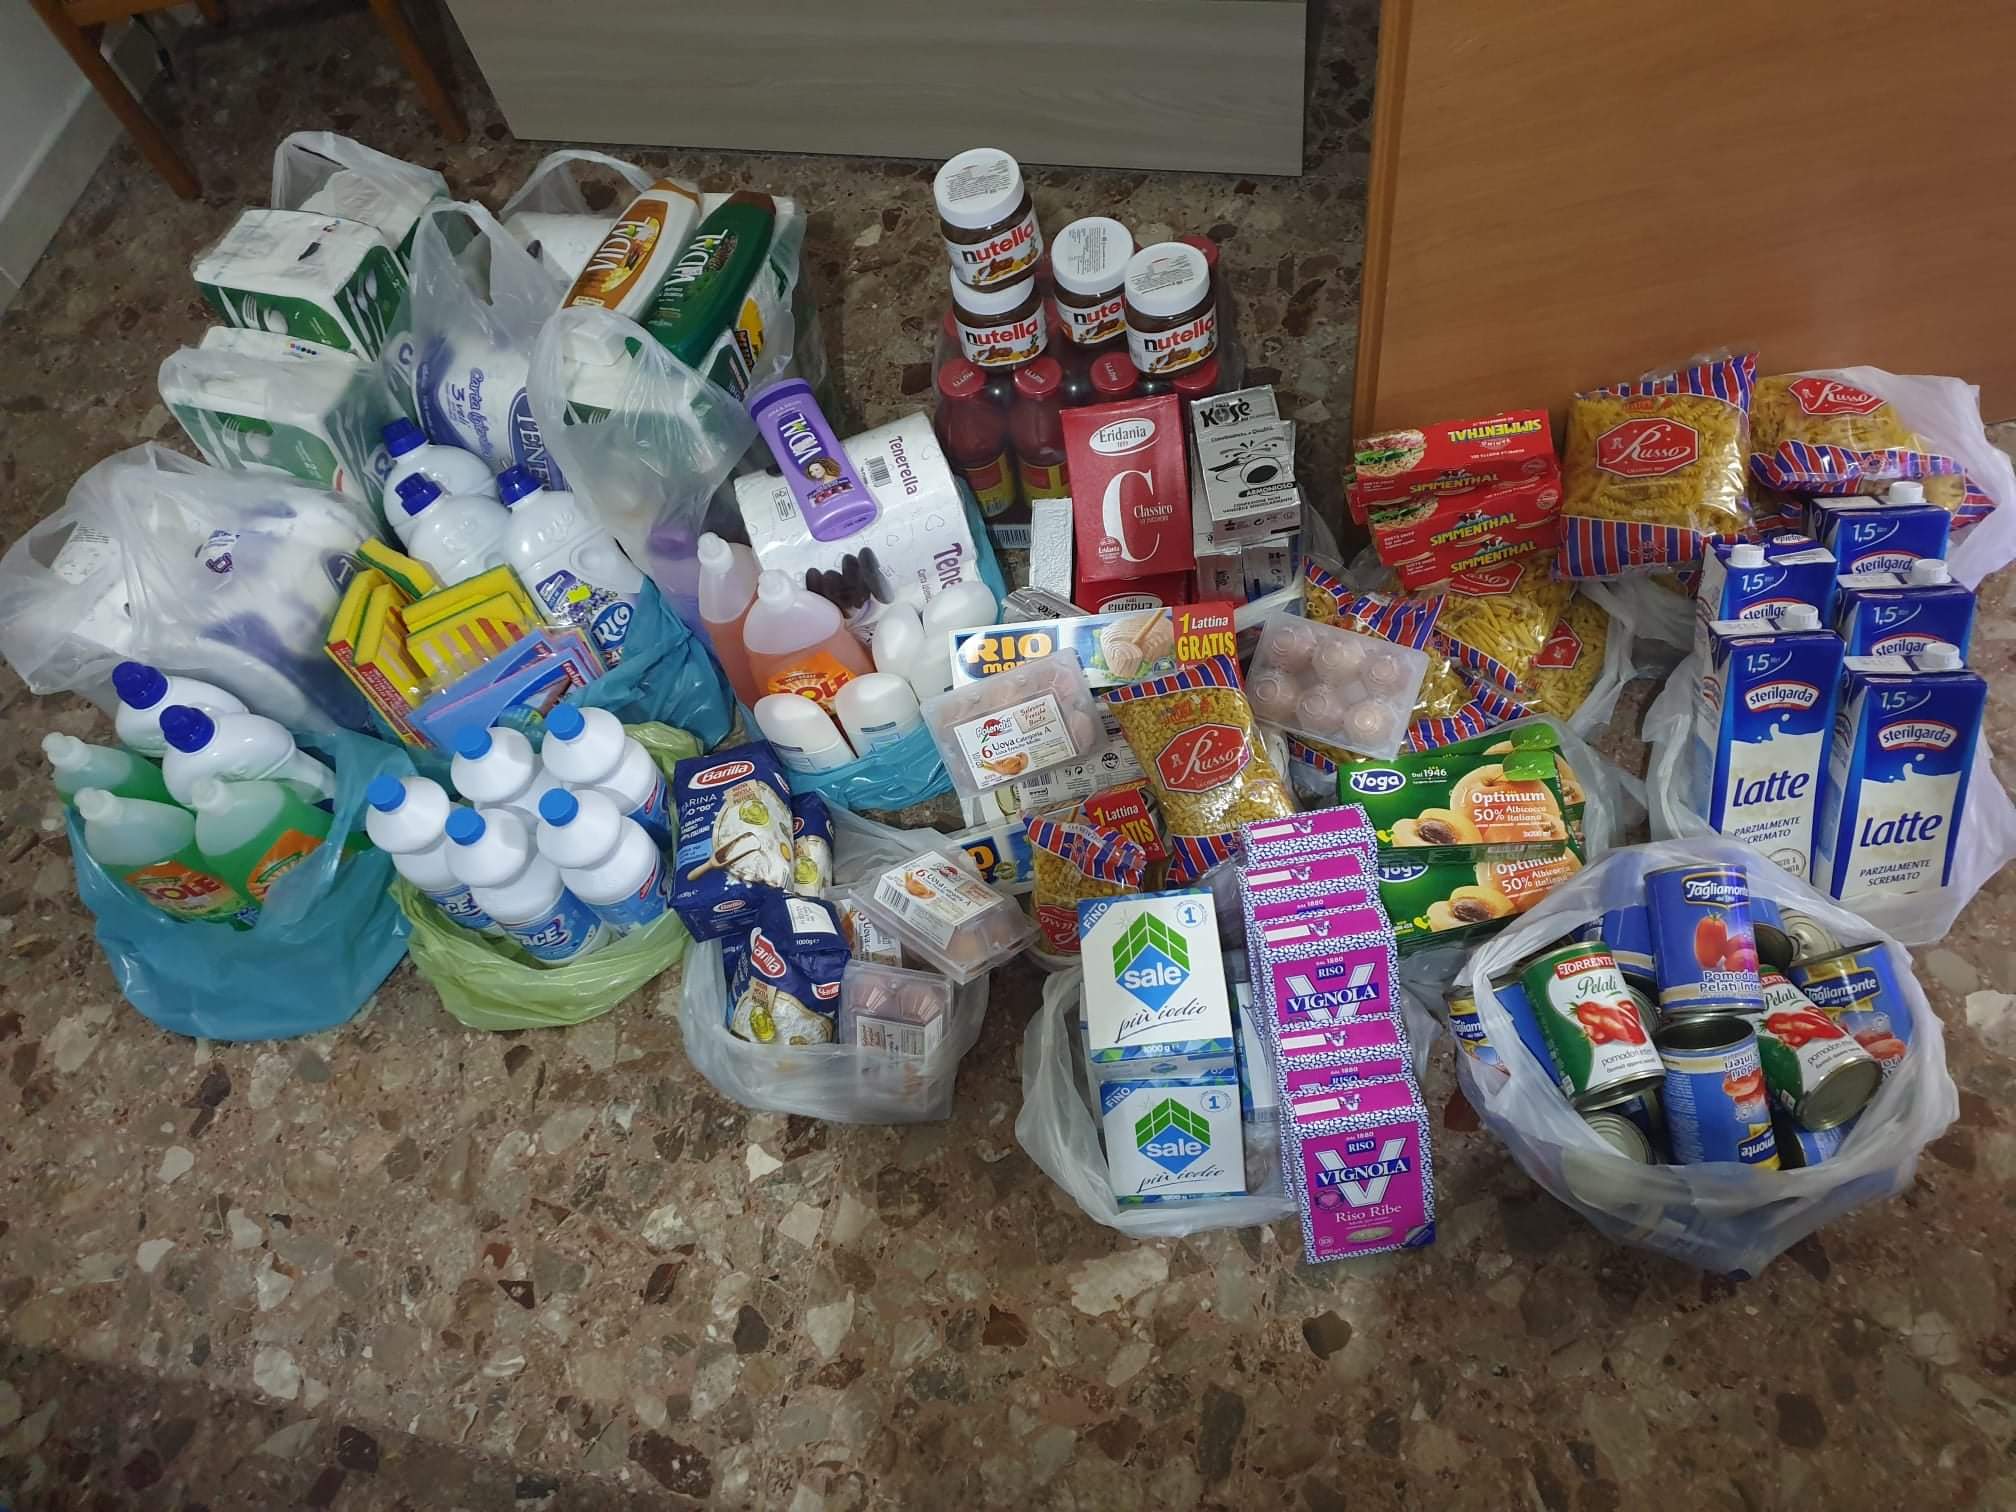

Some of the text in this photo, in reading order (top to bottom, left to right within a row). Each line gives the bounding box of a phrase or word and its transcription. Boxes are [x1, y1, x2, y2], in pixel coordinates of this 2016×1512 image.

[961, 222, 1035, 264] nutella
[1073, 295, 1126, 325] nutel
[964, 318, 1039, 346] nutella
[1143, 316, 1216, 352] nutella
[1099, 426, 1147, 443] Eridania
[1447, 418, 1542, 443] SIMMENTHAL
[1603, 423, 1691, 465] Russo
[888, 435, 920, 496] Tenerella
[1408, 472, 1499, 494] SIMMENTHAL
[1101, 469, 1161, 562] C
[1133, 502, 1174, 519] Classico
[1429, 512, 1517, 546] SIMMENTHAL
[1851, 523, 1877, 540] 1,5
[1450, 540, 1537, 574] SIMMENTHAL
[1855, 558, 1914, 574] sterilgard
[1741, 573, 1764, 592] 1,5
[1179, 613, 1229, 633] 1 Lattina
[1873, 606, 1898, 624] 1,5
[966, 633, 1052, 664] RIO
[1177, 633, 1236, 661] GRATIS
[1746, 653, 1771, 673] 1,5
[1748, 684, 1815, 705] sterilgarda
[1880, 691, 1905, 709] 1,5
[1882, 725, 1952, 744] sterilgarda
[981, 745, 993, 759] 6
[992, 739, 1015, 752] Uova
[702, 763, 749, 782] Barilla
[1351, 771, 1400, 793] Yoga
[1423, 767, 1448, 778] 1946
[1471, 790, 1547, 807] Optimum
[1732, 770, 1811, 808] Latte
[1093, 804, 1139, 827] 1 Lattina
[1473, 808, 1505, 822] 50%
[1734, 815, 1801, 837] PARZIALMENTE
[1860, 811, 1944, 848] Latte
[1860, 859, 1932, 878] PARZIALMENTE
[1867, 871, 1921, 887] SCREMATO
[1501, 875, 1533, 893] 50%
[1083, 902, 1108, 930] FINO
[1184, 907, 1197, 924] 1
[518, 926, 563, 947] ACE
[753, 942, 781, 974] arilla
[1124, 962, 1183, 989] sale
[1318, 965, 1345, 978] RISO
[1575, 974, 1617, 999] Pelati
[1804, 976, 1878, 1005] Tagliamonte
[1287, 984, 1378, 1013] VIGNOLA
[1114, 1008, 1152, 1042] più
[1142, 1045, 1163, 1053] 1000
[1105, 1087, 1131, 1108] FINO
[1207, 1096, 1220, 1110] 1
[1356, 1131, 1375, 1139] 1880
[1145, 1137, 1203, 1158] sale
[1348, 1140, 1375, 1153] RISO
[1317, 1159, 1409, 1185] VIGNOLA
[1335, 1204, 1402, 1223] Riso Ribe
